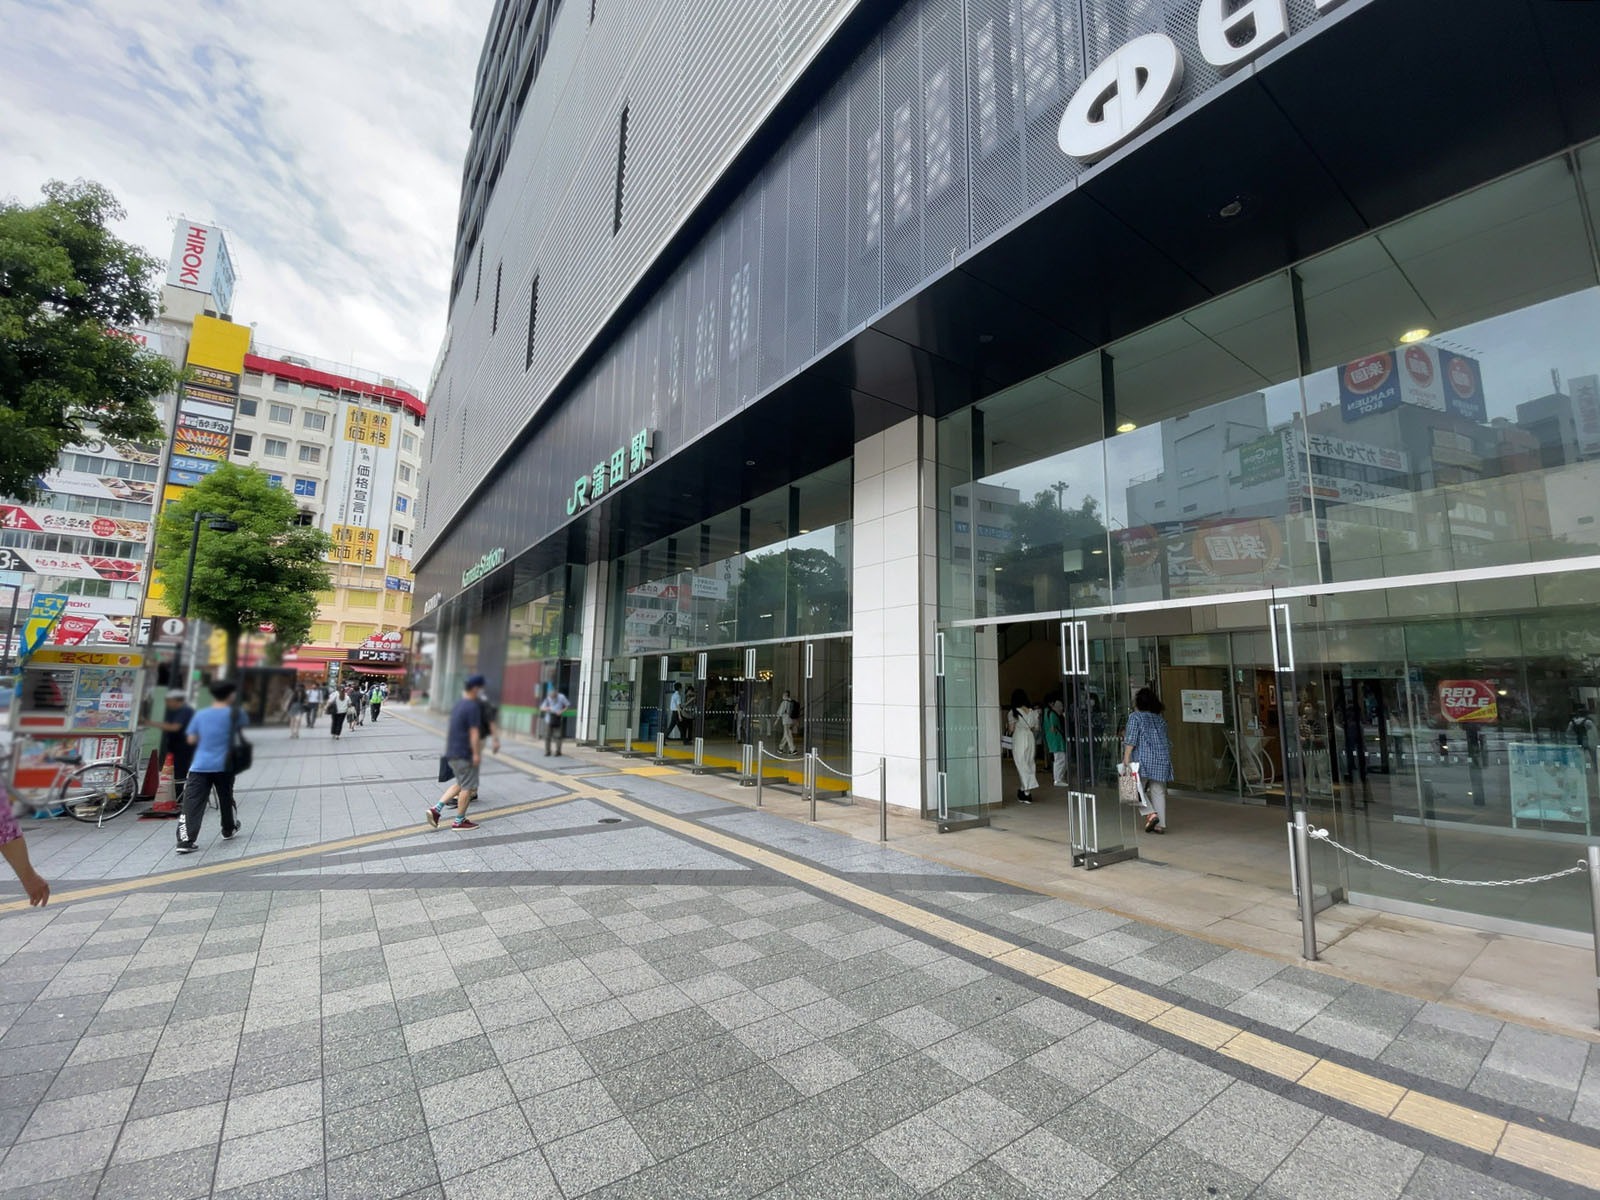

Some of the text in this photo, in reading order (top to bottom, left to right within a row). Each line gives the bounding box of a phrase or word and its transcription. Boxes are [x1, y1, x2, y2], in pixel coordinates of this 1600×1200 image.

[179, 226, 207, 286] HIROKI
[59, 652, 104, 664] 宝くじ
[1440, 687, 1477, 698] RED
[1445, 697, 1491, 708] SALE
